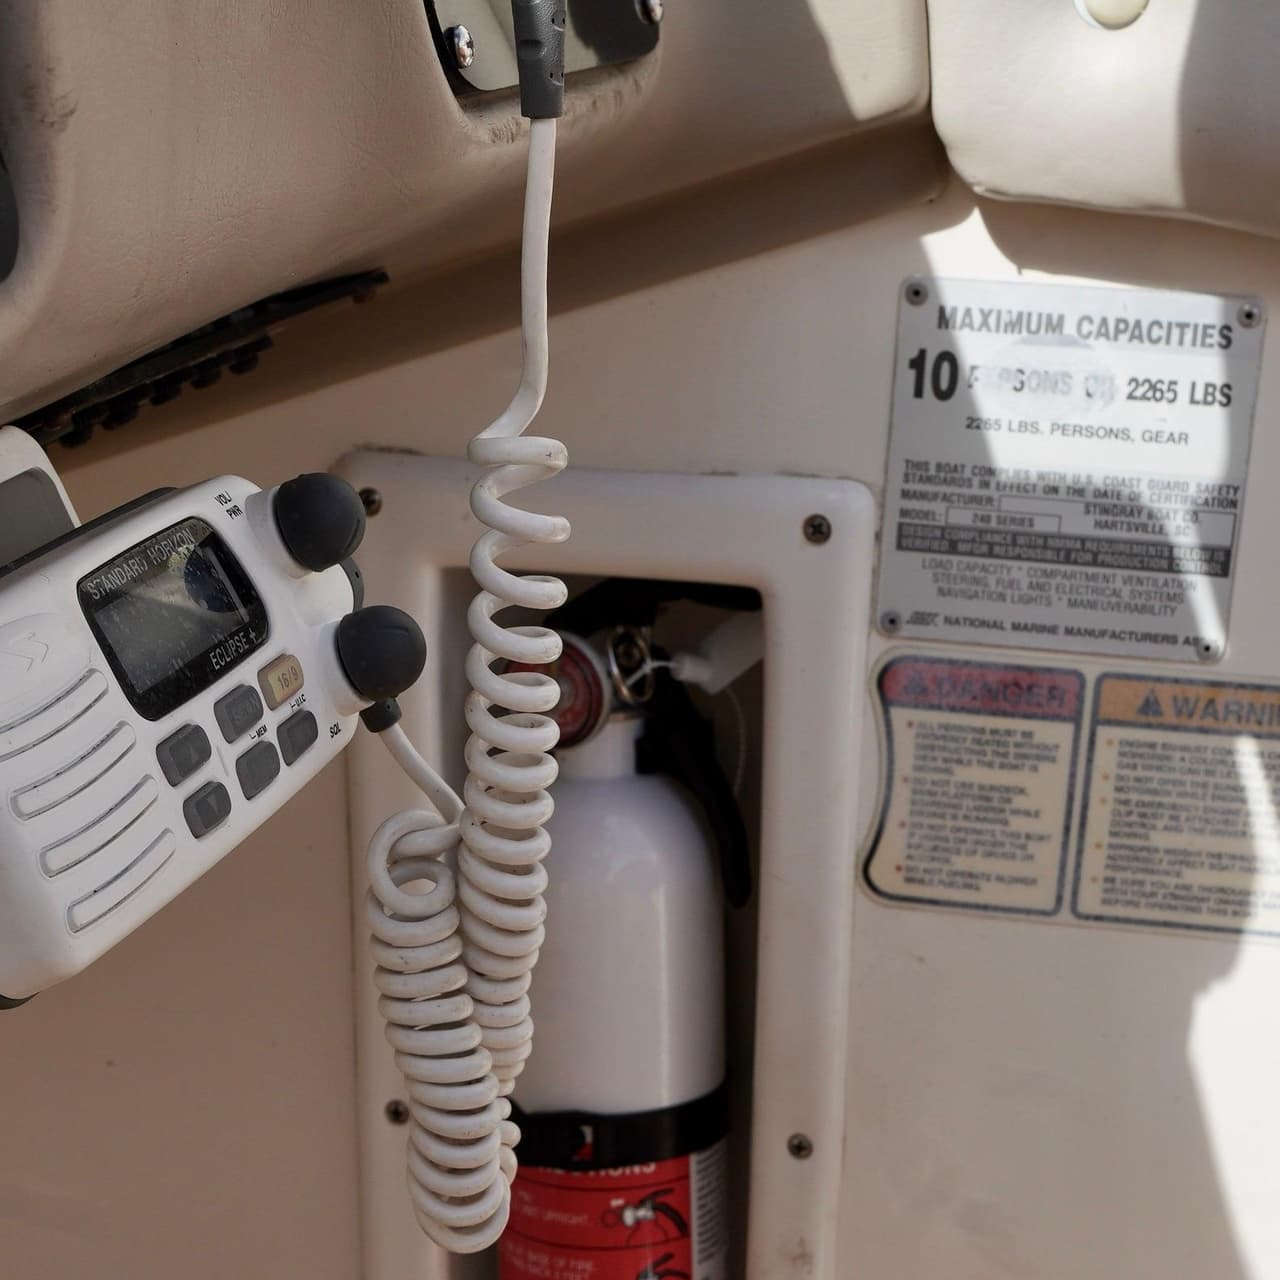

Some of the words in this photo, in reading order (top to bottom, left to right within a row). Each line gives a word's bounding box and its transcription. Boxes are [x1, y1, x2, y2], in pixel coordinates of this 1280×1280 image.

[937, 305, 1066, 335] MAXIMUM
[1076, 316, 1233, 349] CAPACITIES
[907, 348, 959, 402] 10
[1126, 377, 1178, 404] 2265
[1189, 381, 1233, 407] LBS
[965, 416, 1002, 432] 2265
[1141, 429, 1190, 446] GEAR
[902, 473, 972, 489] STANDARDS
[995, 480, 1037, 494] EFFECT
[1042, 483, 1059, 496] ON
[1064, 485, 1086, 498] THE
[1092, 487, 1123, 500] DATE
[904, 460, 930, 472] THIS
[935, 462, 966, 475] BOAT
[1102, 474, 1142, 488] COAST
[1146, 478, 1190, 492] GUARD
[1194, 481, 1240, 495] SAFETY
[1083, 502, 1143, 519] STINGRAY
[86, 556, 148, 600] STANDARD
[148, 528, 197, 567] HORIZON
[921, 558, 953, 571] LOAD
[956, 561, 1012, 576] CAPACITY
[1026, 567, 1118, 585] COMPARTMENT
[936, 586, 1008, 603] NAVIGATION
[1010, 592, 1053, 607] LIGHTS
[1027, 580, 1052, 593] AND
[1055, 583, 1125, 599] ELECTRICAL
[1128, 589, 1184, 604] SYSTEMS
[944, 615, 1007, 631] NATIONAL
[1012, 621, 1059, 635] MARINE
[1064, 626, 1178, 646] MANUFACTURERS
[210, 632, 250, 670] ECLIPSE
[277, 666, 300, 690] 16/9
[934, 673, 1065, 708] DANGER
